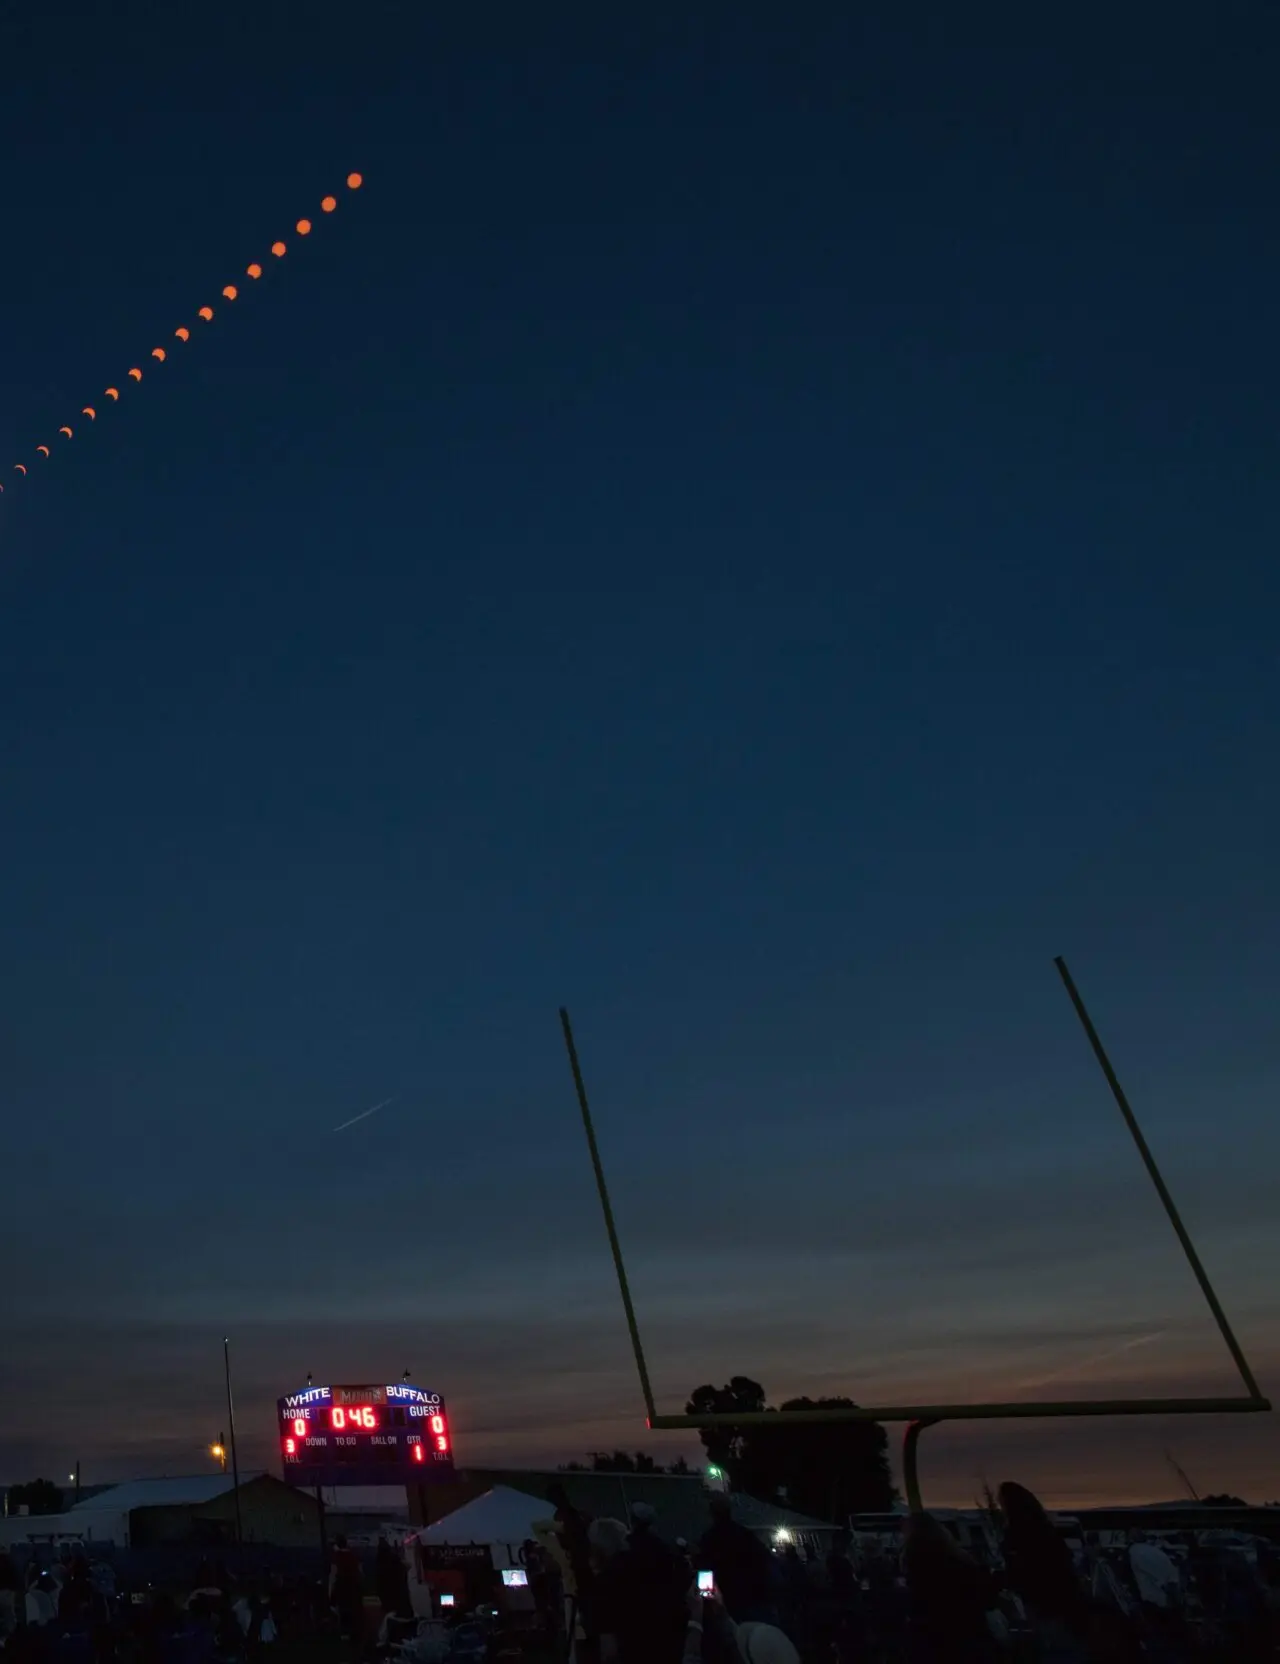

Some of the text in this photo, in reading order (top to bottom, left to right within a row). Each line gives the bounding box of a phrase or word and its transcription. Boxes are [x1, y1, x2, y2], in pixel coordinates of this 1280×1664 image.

[285, 1387, 331, 1407] WHITE
[386, 1385, 440, 1404] BUFFALO
[283, 1408, 311, 1419] HOME
[409, 1406, 440, 1417] GUEST
[294, 1418, 306, 1437] 0
[431, 1415, 444, 1434] 0
[285, 1438, 295, 1454] 3
[305, 1437, 327, 1446] DOWN
[335, 1437, 357, 1445] TO GO
[370, 1436, 397, 1445] BALL ON
[437, 1435, 447, 1451] 3
[413, 1444, 423, 1462] 1
